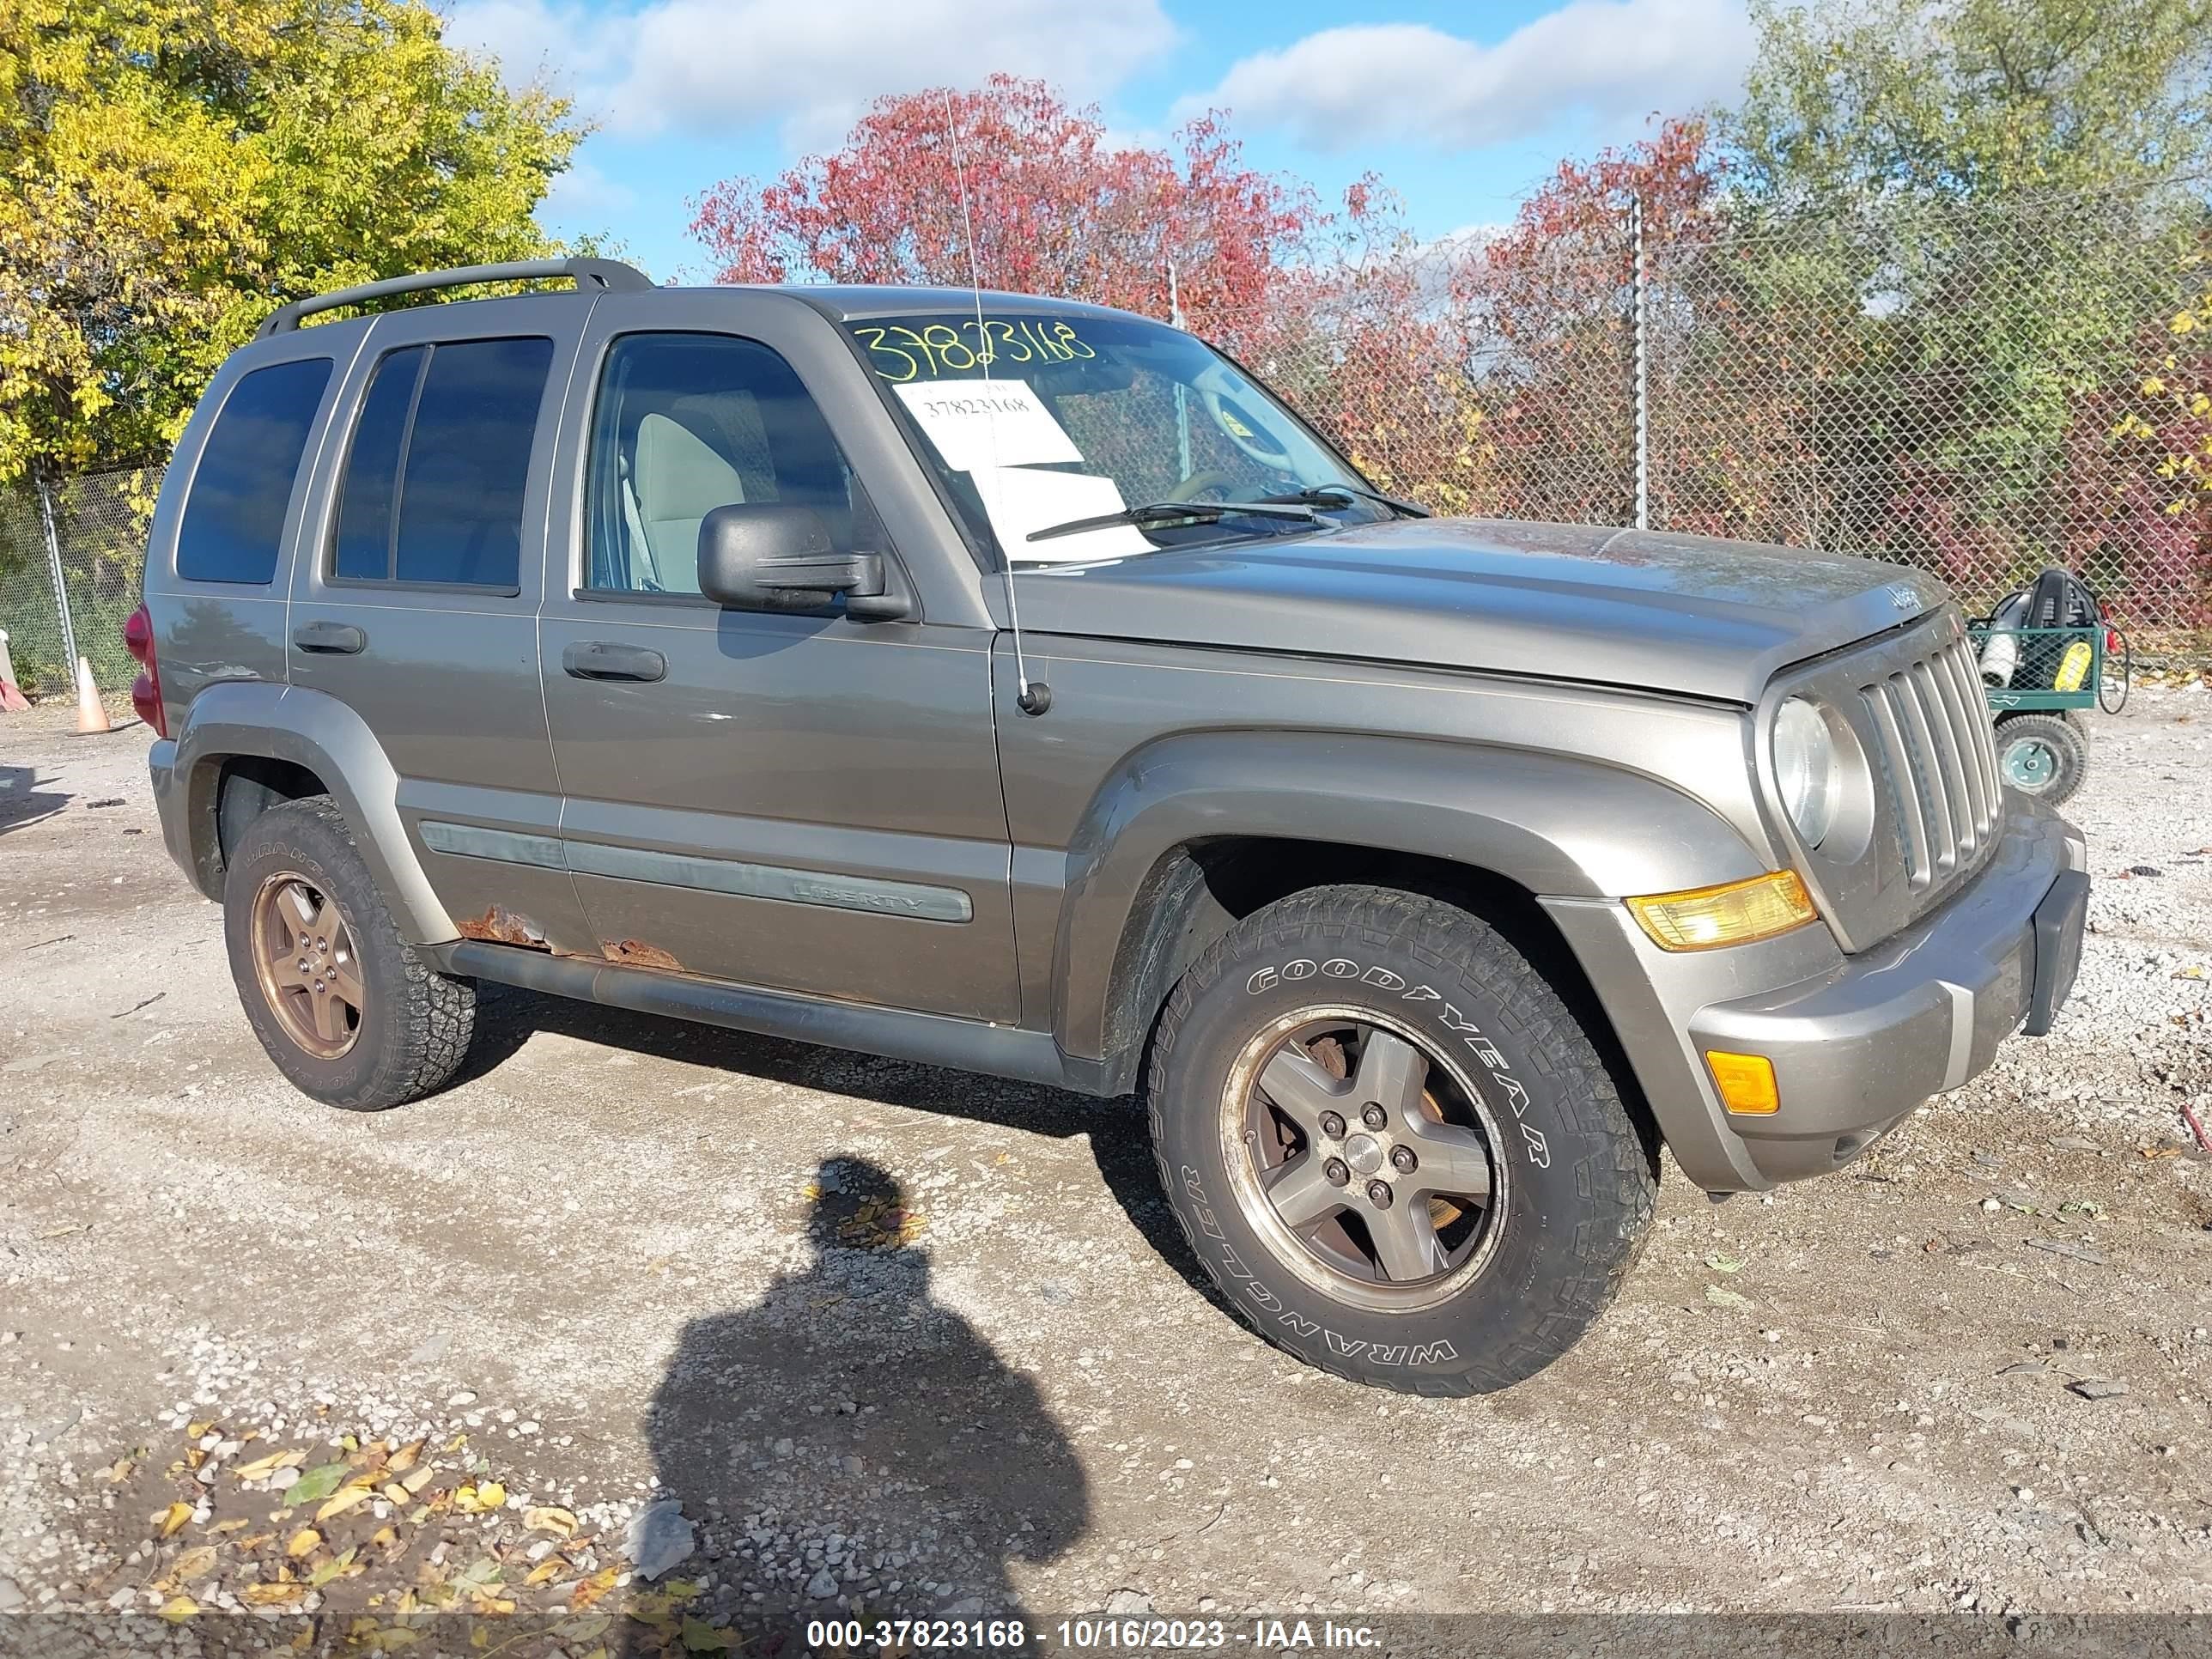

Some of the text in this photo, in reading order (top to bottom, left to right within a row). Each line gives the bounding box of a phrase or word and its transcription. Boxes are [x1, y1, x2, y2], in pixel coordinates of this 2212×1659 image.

[854, 320, 1096, 380] 37823168
[923, 397, 1030, 418] 37823168
[793, 883, 924, 911] LIBERTY
[1246, 957, 1552, 1170] GOODYEAR
[1180, 1164, 1460, 1366] WRANGLER
